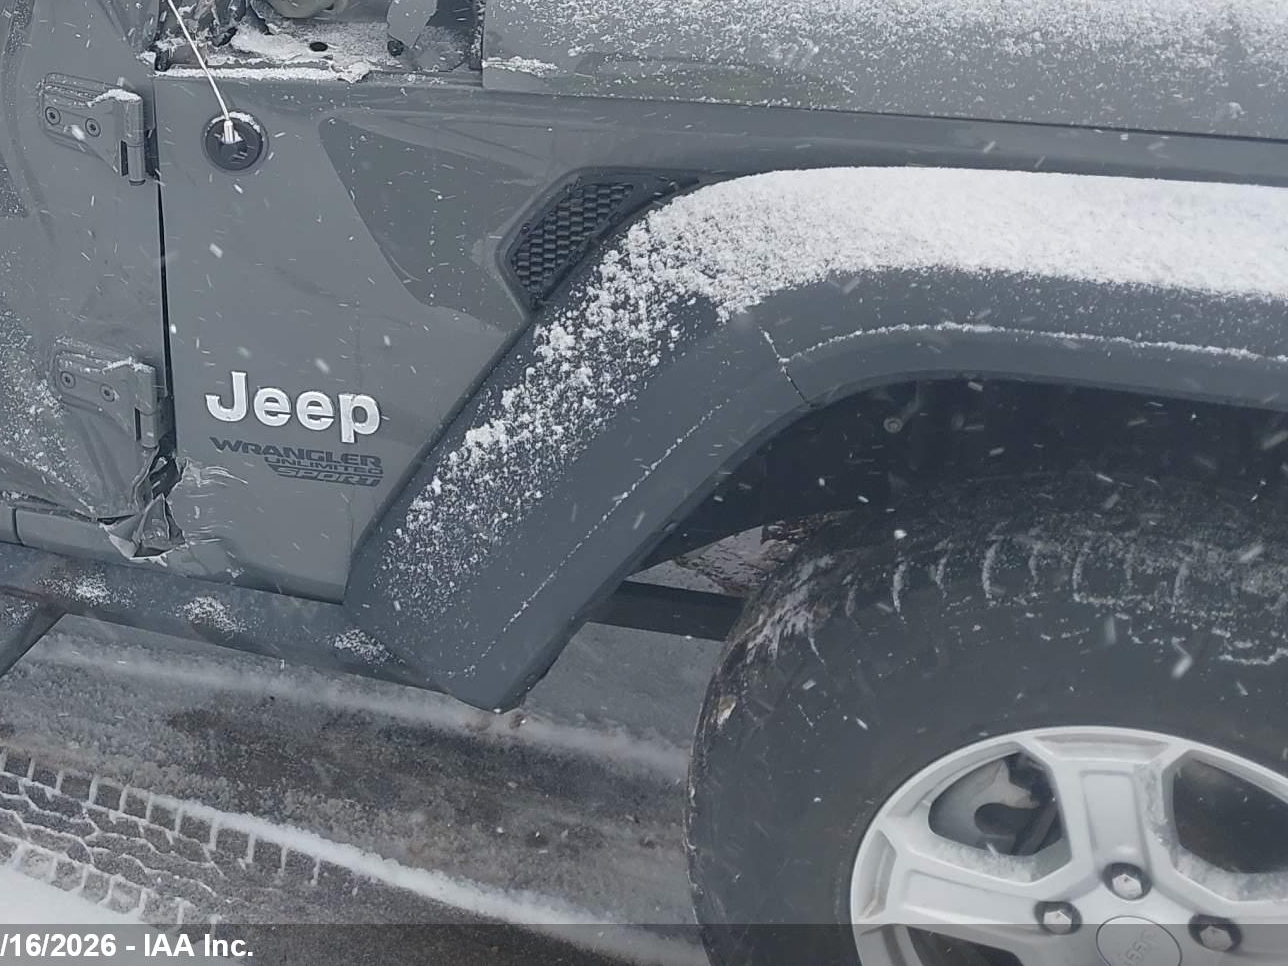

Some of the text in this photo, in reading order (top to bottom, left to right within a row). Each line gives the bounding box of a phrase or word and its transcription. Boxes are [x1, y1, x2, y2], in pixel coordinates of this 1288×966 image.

[205, 371, 381, 444] Jeep
[210, 436, 383, 467] WRANGLER
[264, 456, 384, 475] UNLIMITED
[272, 466, 382, 487] SPORT
